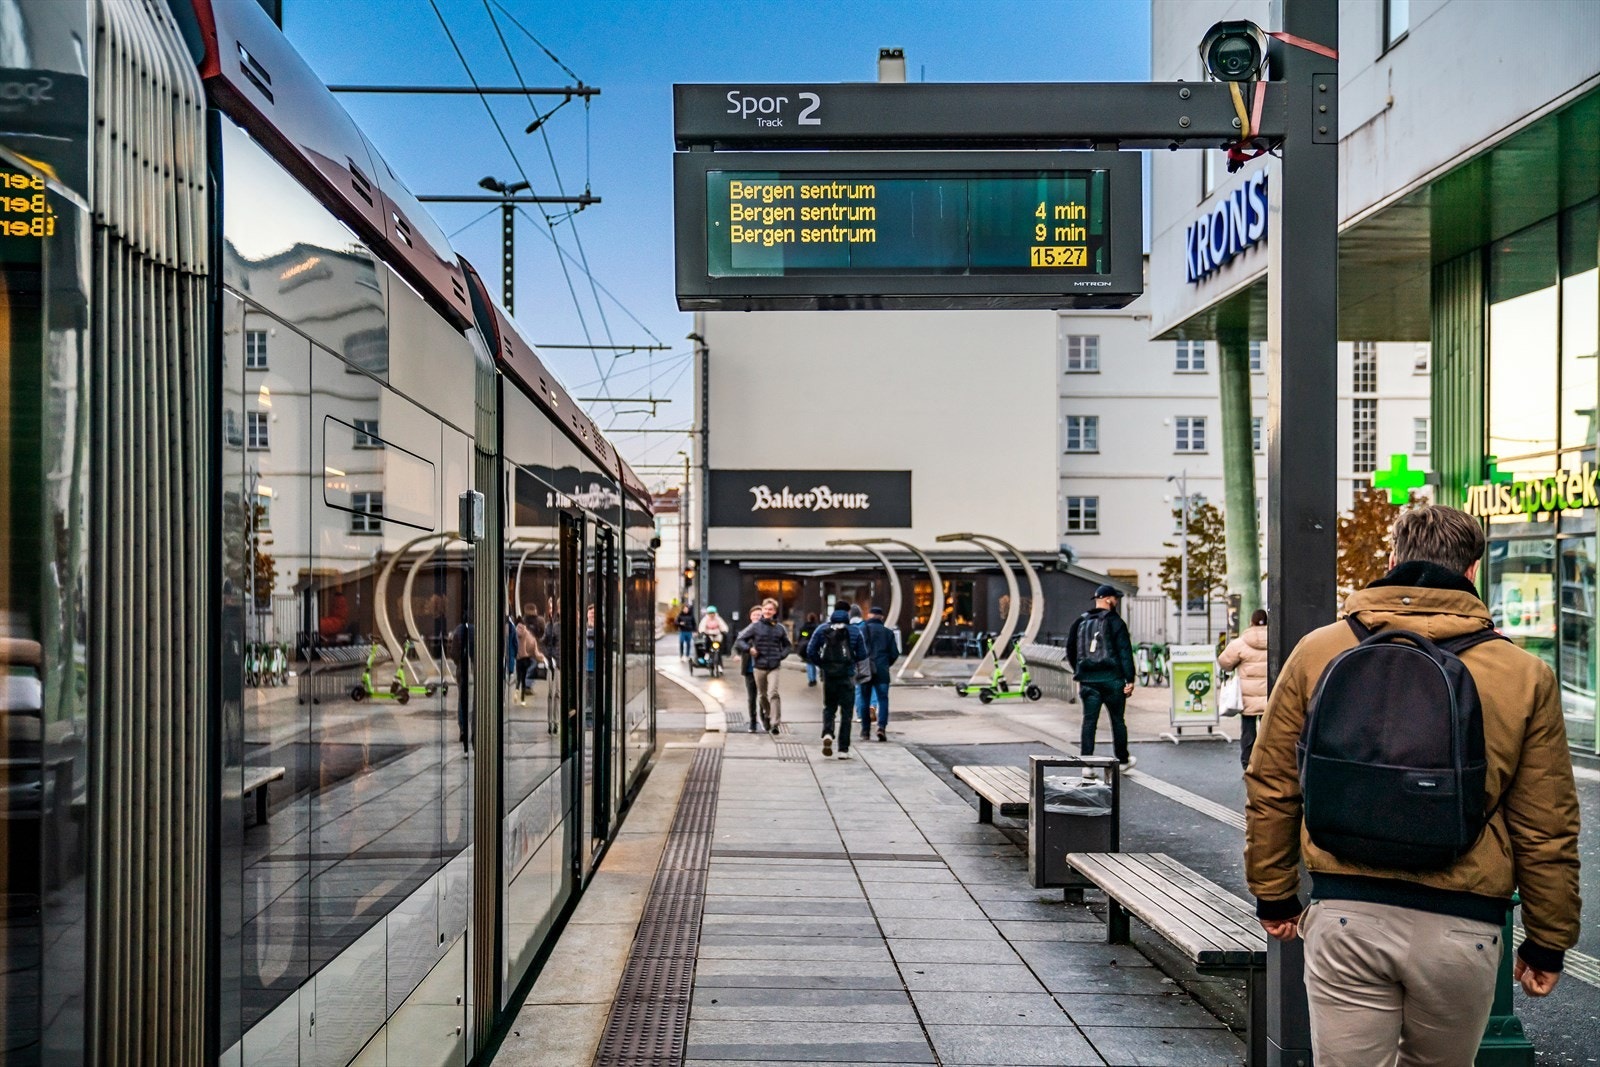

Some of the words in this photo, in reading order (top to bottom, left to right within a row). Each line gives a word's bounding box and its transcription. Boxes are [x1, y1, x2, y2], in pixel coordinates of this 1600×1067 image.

[727, 90, 789, 119] Spor
[798, 92, 821, 125] 2
[756, 117, 783, 127] Track
[730, 181, 795, 203] Bergen
[800, 181, 876, 199] sentrum
[730, 203, 795, 225] Bergen
[800, 203, 876, 221] sentrum
[1035, 201, 1047, 219] 4
[1055, 201, 1086, 219] min
[730, 225, 795, 247] Bergen
[800, 224, 876, 242] sentrum
[1035, 223, 1047, 241] 9
[1055, 223, 1086, 241] min
[1033, 248, 1085, 265] 15:27
[750, 484, 870, 511] BakerBrun
